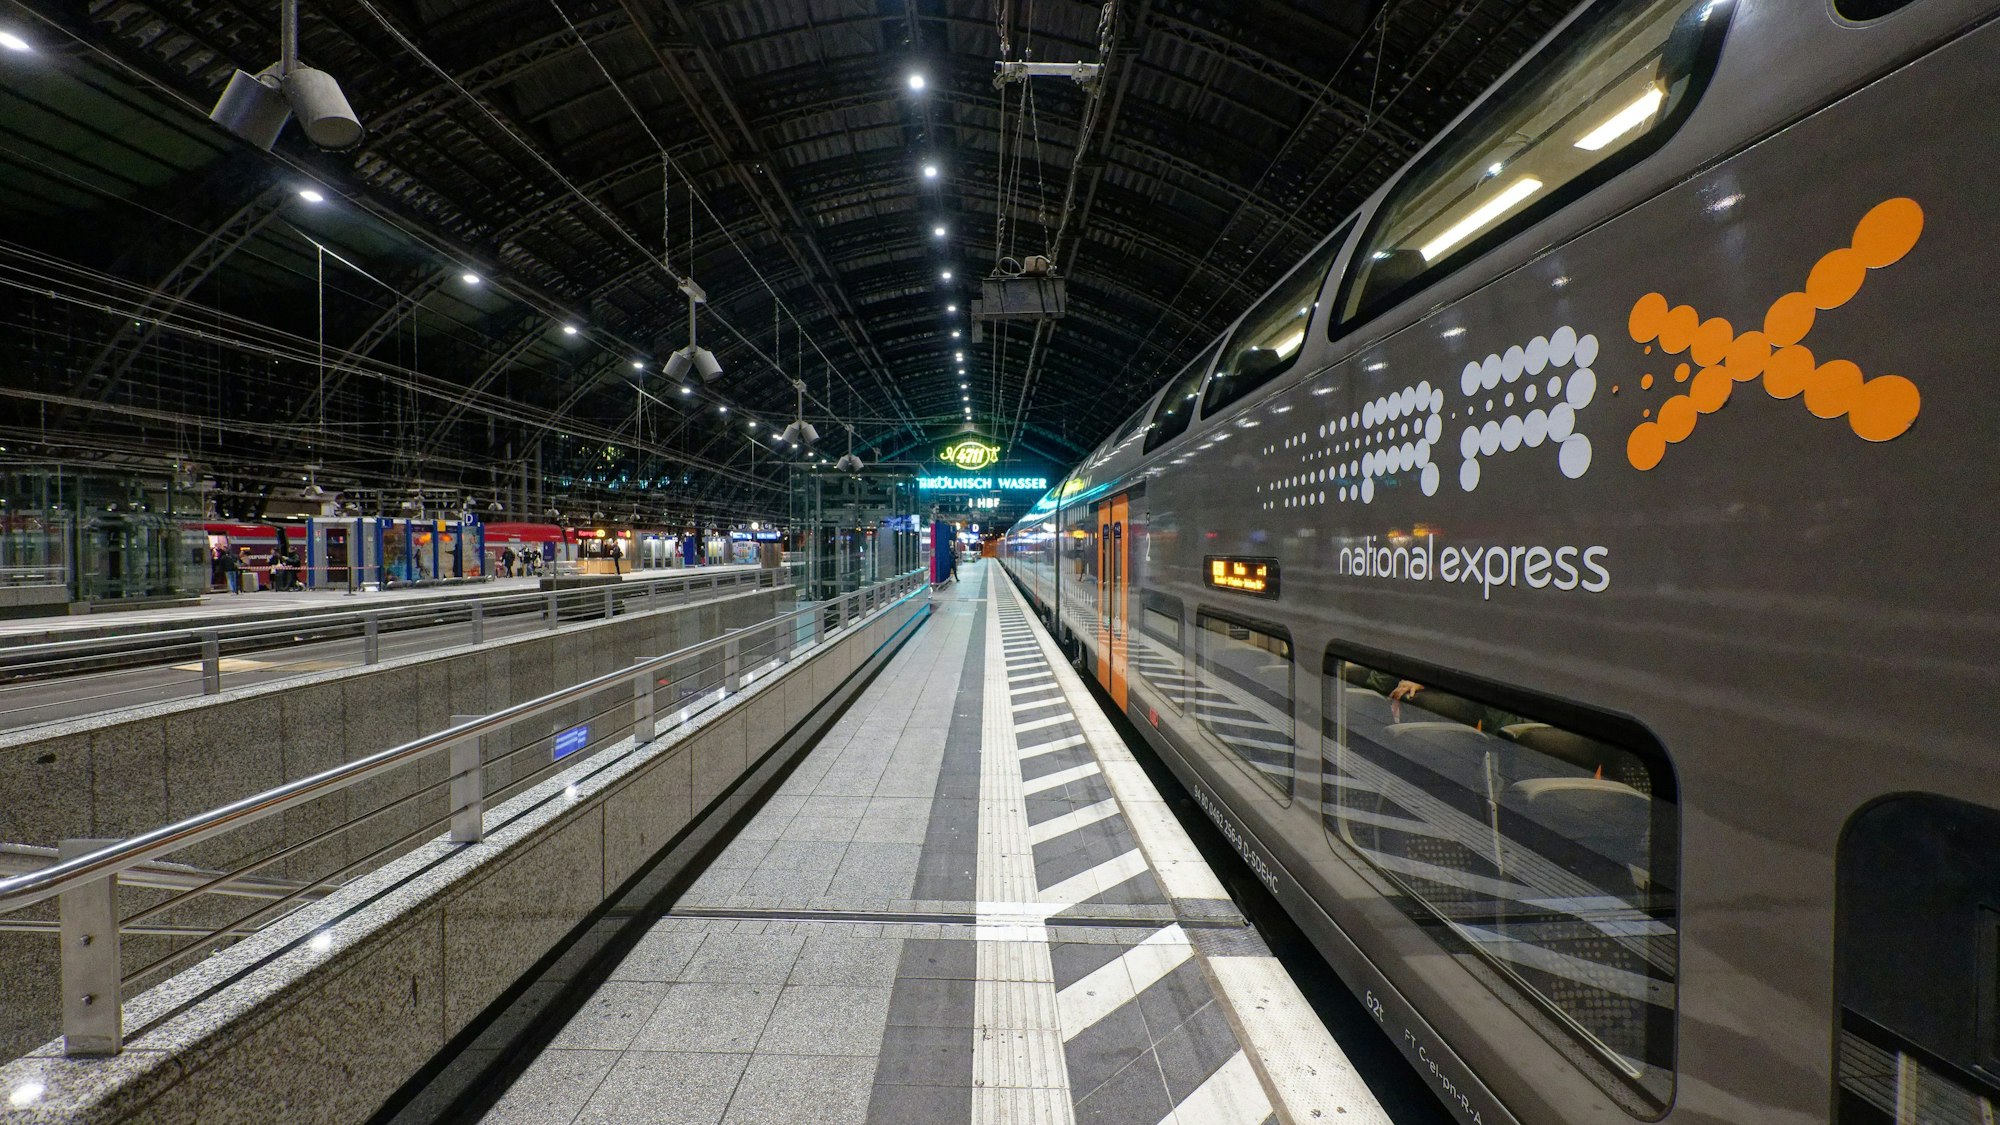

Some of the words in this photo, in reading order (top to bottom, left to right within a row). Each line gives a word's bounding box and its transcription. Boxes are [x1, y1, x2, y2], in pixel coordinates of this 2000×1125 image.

[956, 447, 985, 464] 4711
[998, 476, 1047, 490] WASSER
[977, 497, 1001, 509] HBF
[465, 514, 474, 524] D
[972, 523, 980, 532] D
[1145, 532, 1151, 562] 2
[1339, 533, 1434, 581] national
[1440, 545, 1610, 601] express
[1194, 784, 1201, 801] 94
[1208, 802, 1224, 829] 0462
[1243, 840, 1279, 894] D-SDEHC
[1366, 990, 1384, 1023] 62t
[1404, 1028, 1417, 1049] FT
